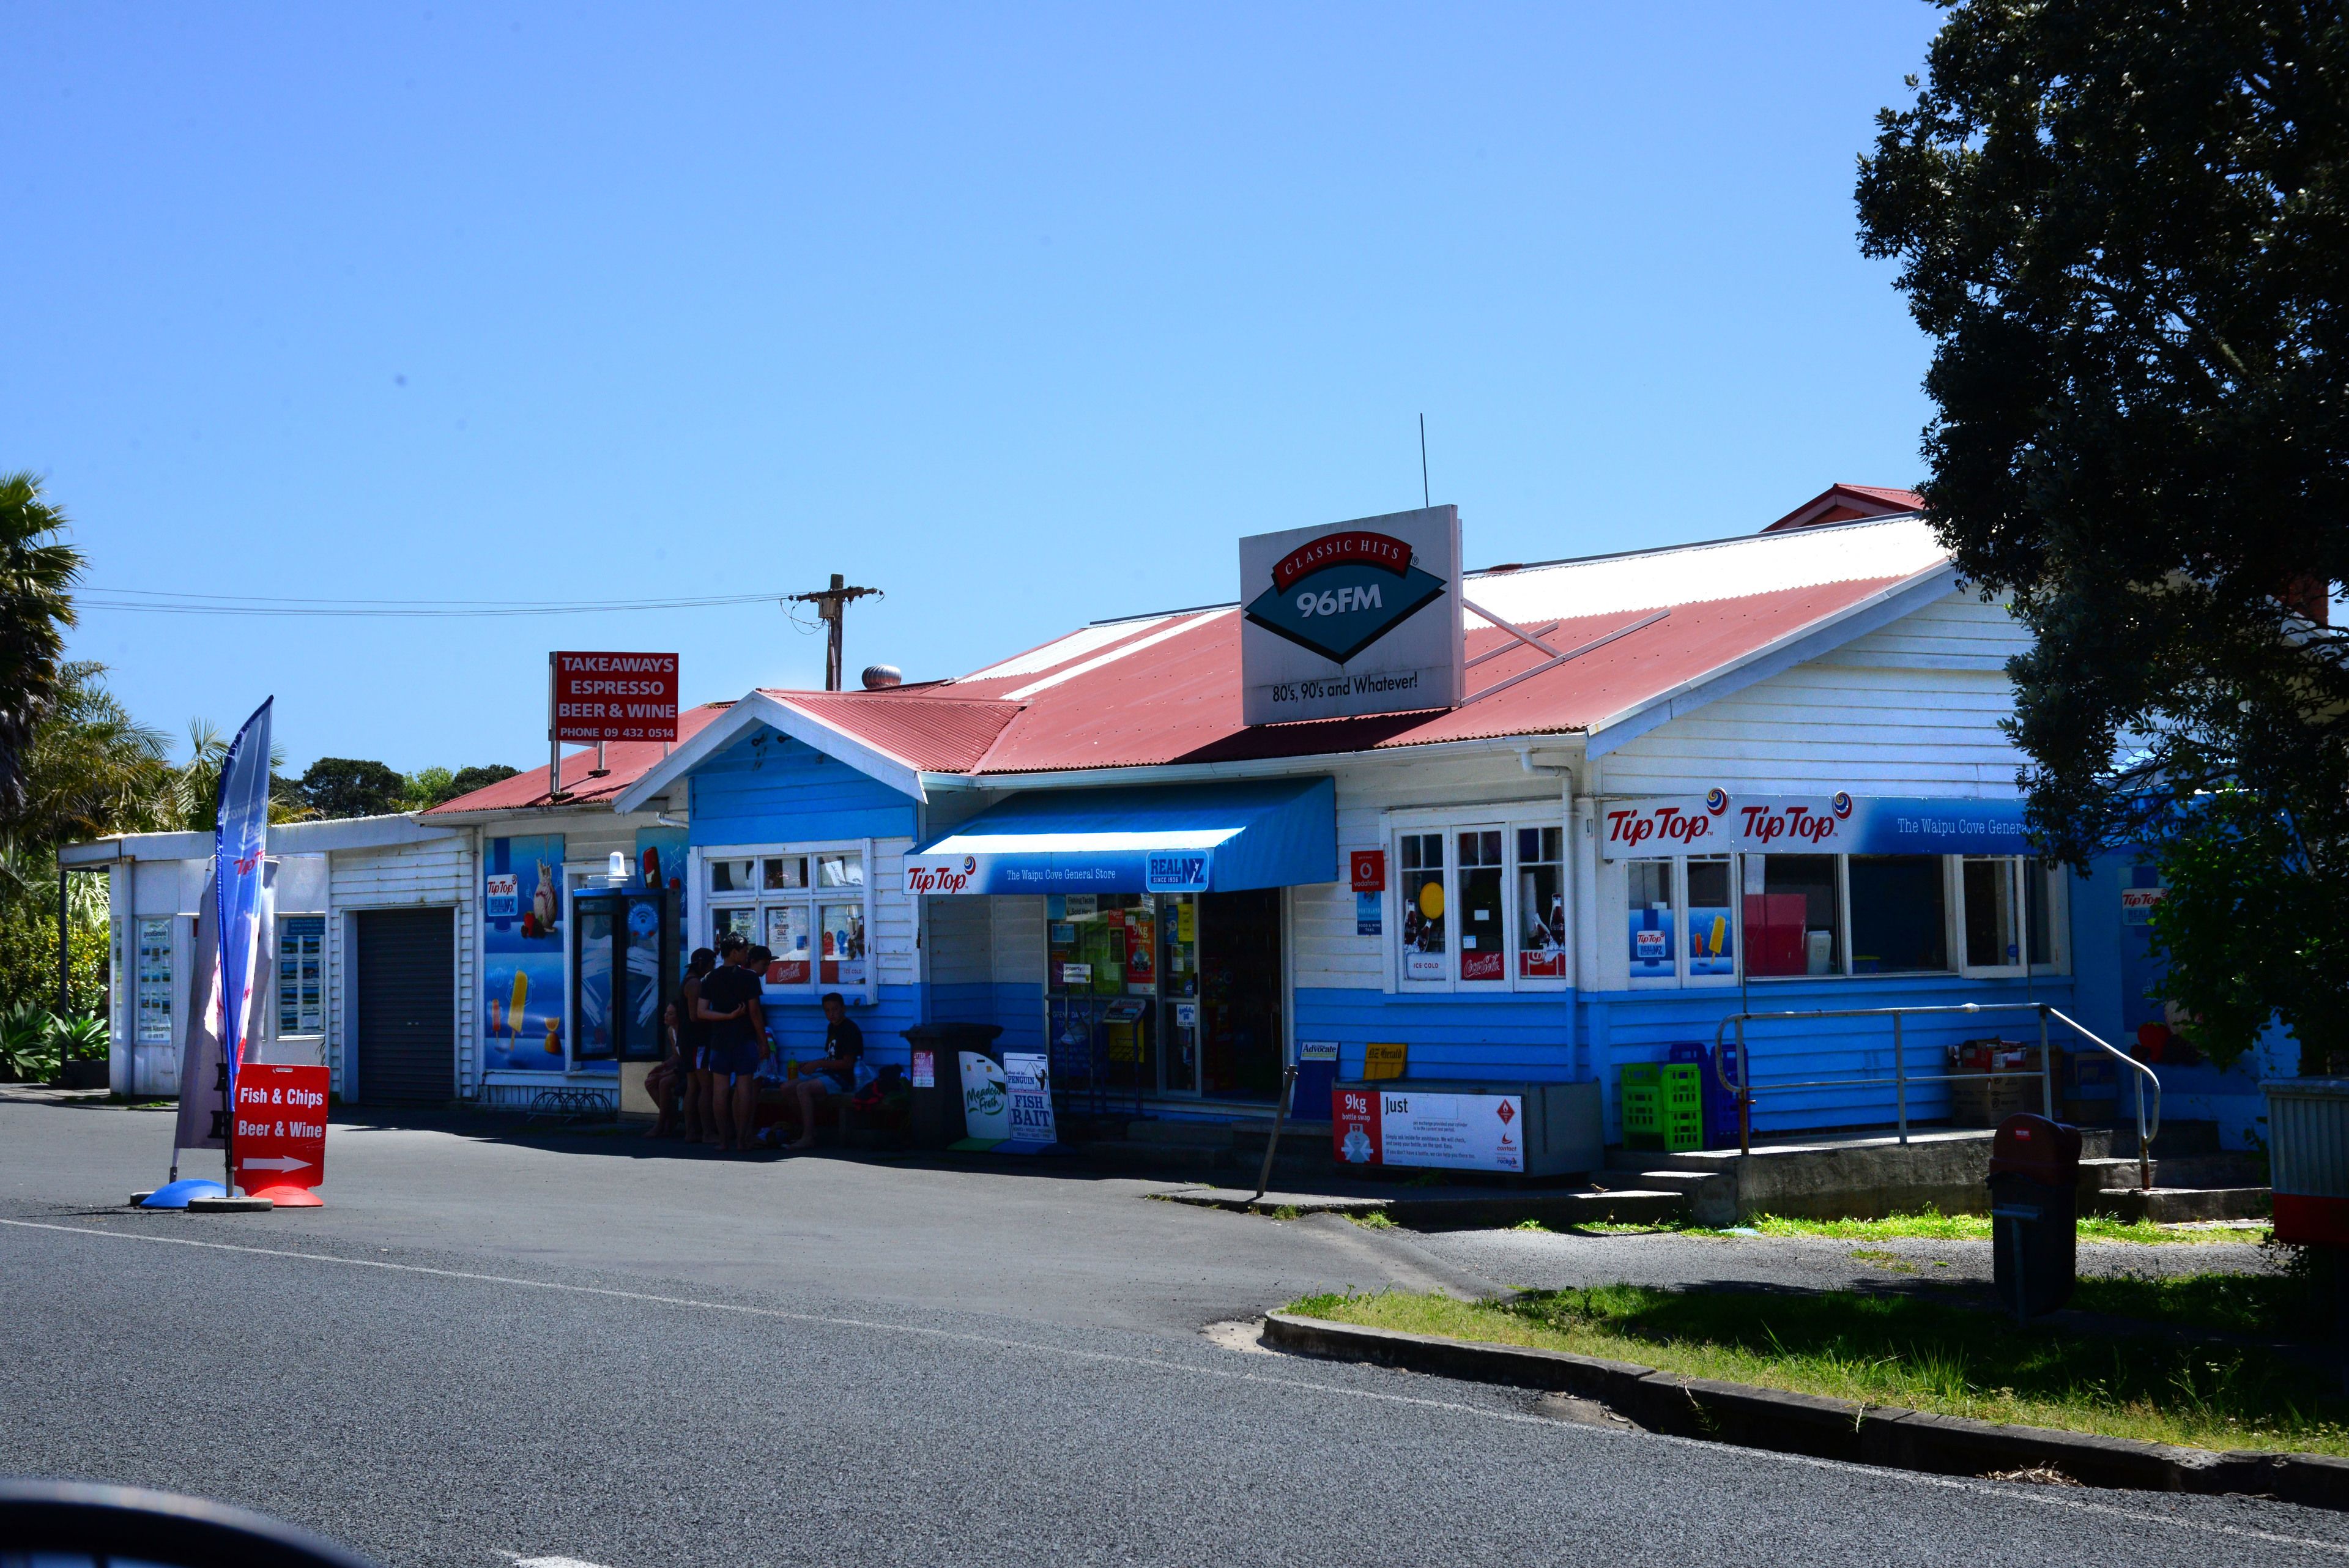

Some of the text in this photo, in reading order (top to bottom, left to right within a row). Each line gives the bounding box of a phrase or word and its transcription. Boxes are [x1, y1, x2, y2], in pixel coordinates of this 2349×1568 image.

[1285, 540, 1399, 576] CLASSIC HITS
[1296, 584, 1382, 618] 96FM
[562, 657, 674, 672] TAKEAWAYS
[571, 680, 665, 696] ESPRESSO
[1273, 671, 1418, 703] 80's, 90's and Whatever!
[558, 703, 676, 718] BEER & WINE
[560, 727, 675, 738] PHONE 09 432 0514
[1608, 807, 1709, 847] Tip Top
[1741, 806, 1835, 844] Tip Top
[1898, 818, 1918, 833] The
[1921, 818, 1956, 837] Waipu
[1959, 819, 1985, 834] Cove
[908, 867, 967, 894] Tip Top
[1007, 868, 1116, 882] The Waipu Cove General Store
[1150, 858, 1204, 884] REAL NZ
[488, 881, 513, 895] Tip Top
[2123, 894, 2140, 907] Tip
[1132, 923, 1148, 938] 9kg
[1638, 934, 1661, 944] Tip Top
[1302, 1044, 1337, 1053] Advocate
[1008, 1076, 1034, 1085] PENGUIN
[240, 1087, 324, 1109] Fish & Chips
[967, 1082, 1001, 1107] Meadow
[979, 1094, 999, 1113] Fresh
[1014, 1094, 1044, 1109] FISH
[1345, 1093, 1367, 1114] 9kg
[1385, 1096, 1408, 1115] Just
[1011, 1108, 1050, 1127] BAIT
[1342, 1112, 1357, 1121] bottle
[238, 1120, 322, 1139] Beer & Wine
